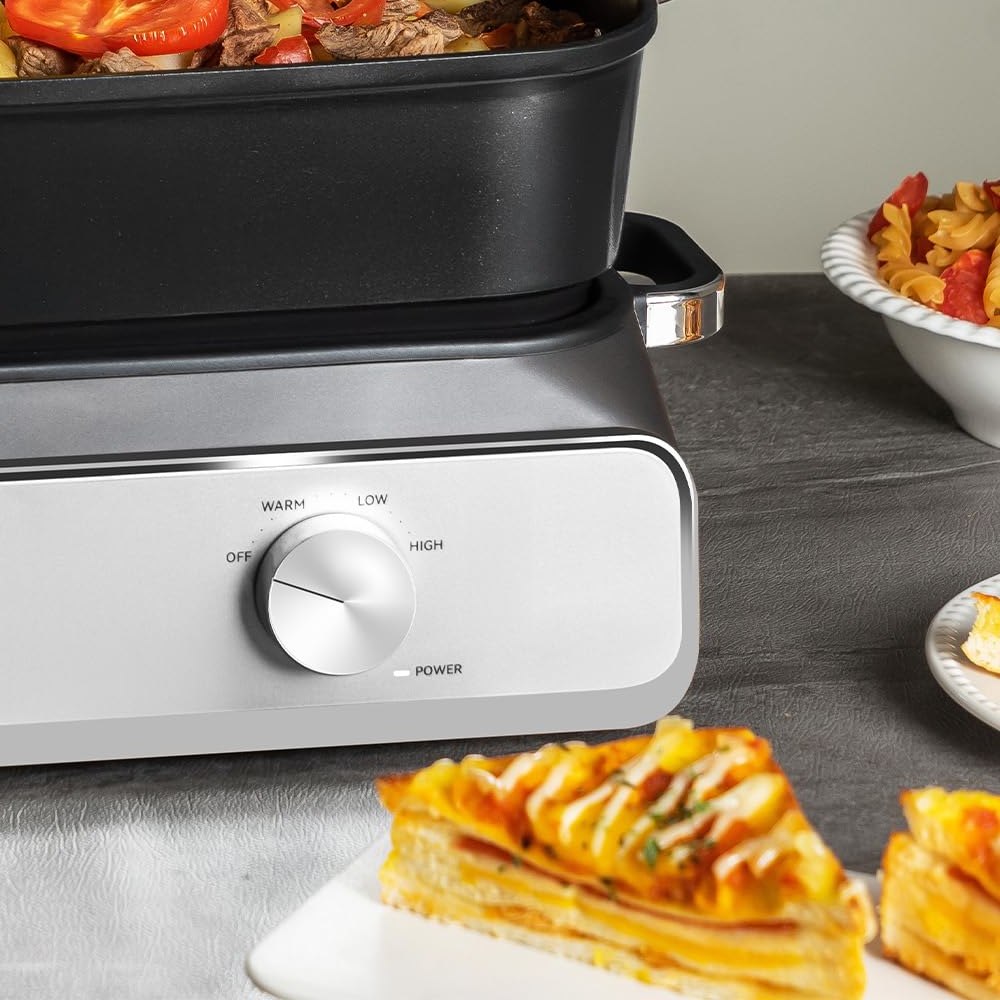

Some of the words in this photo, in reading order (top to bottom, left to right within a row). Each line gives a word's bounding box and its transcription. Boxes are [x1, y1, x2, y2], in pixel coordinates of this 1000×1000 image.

[260, 499, 306, 513] WARM
[357, 493, 389, 507] LOW
[409, 539, 444, 552] HIGH
[225, 550, 253, 563] OFF
[414, 663, 463, 677] POWER
